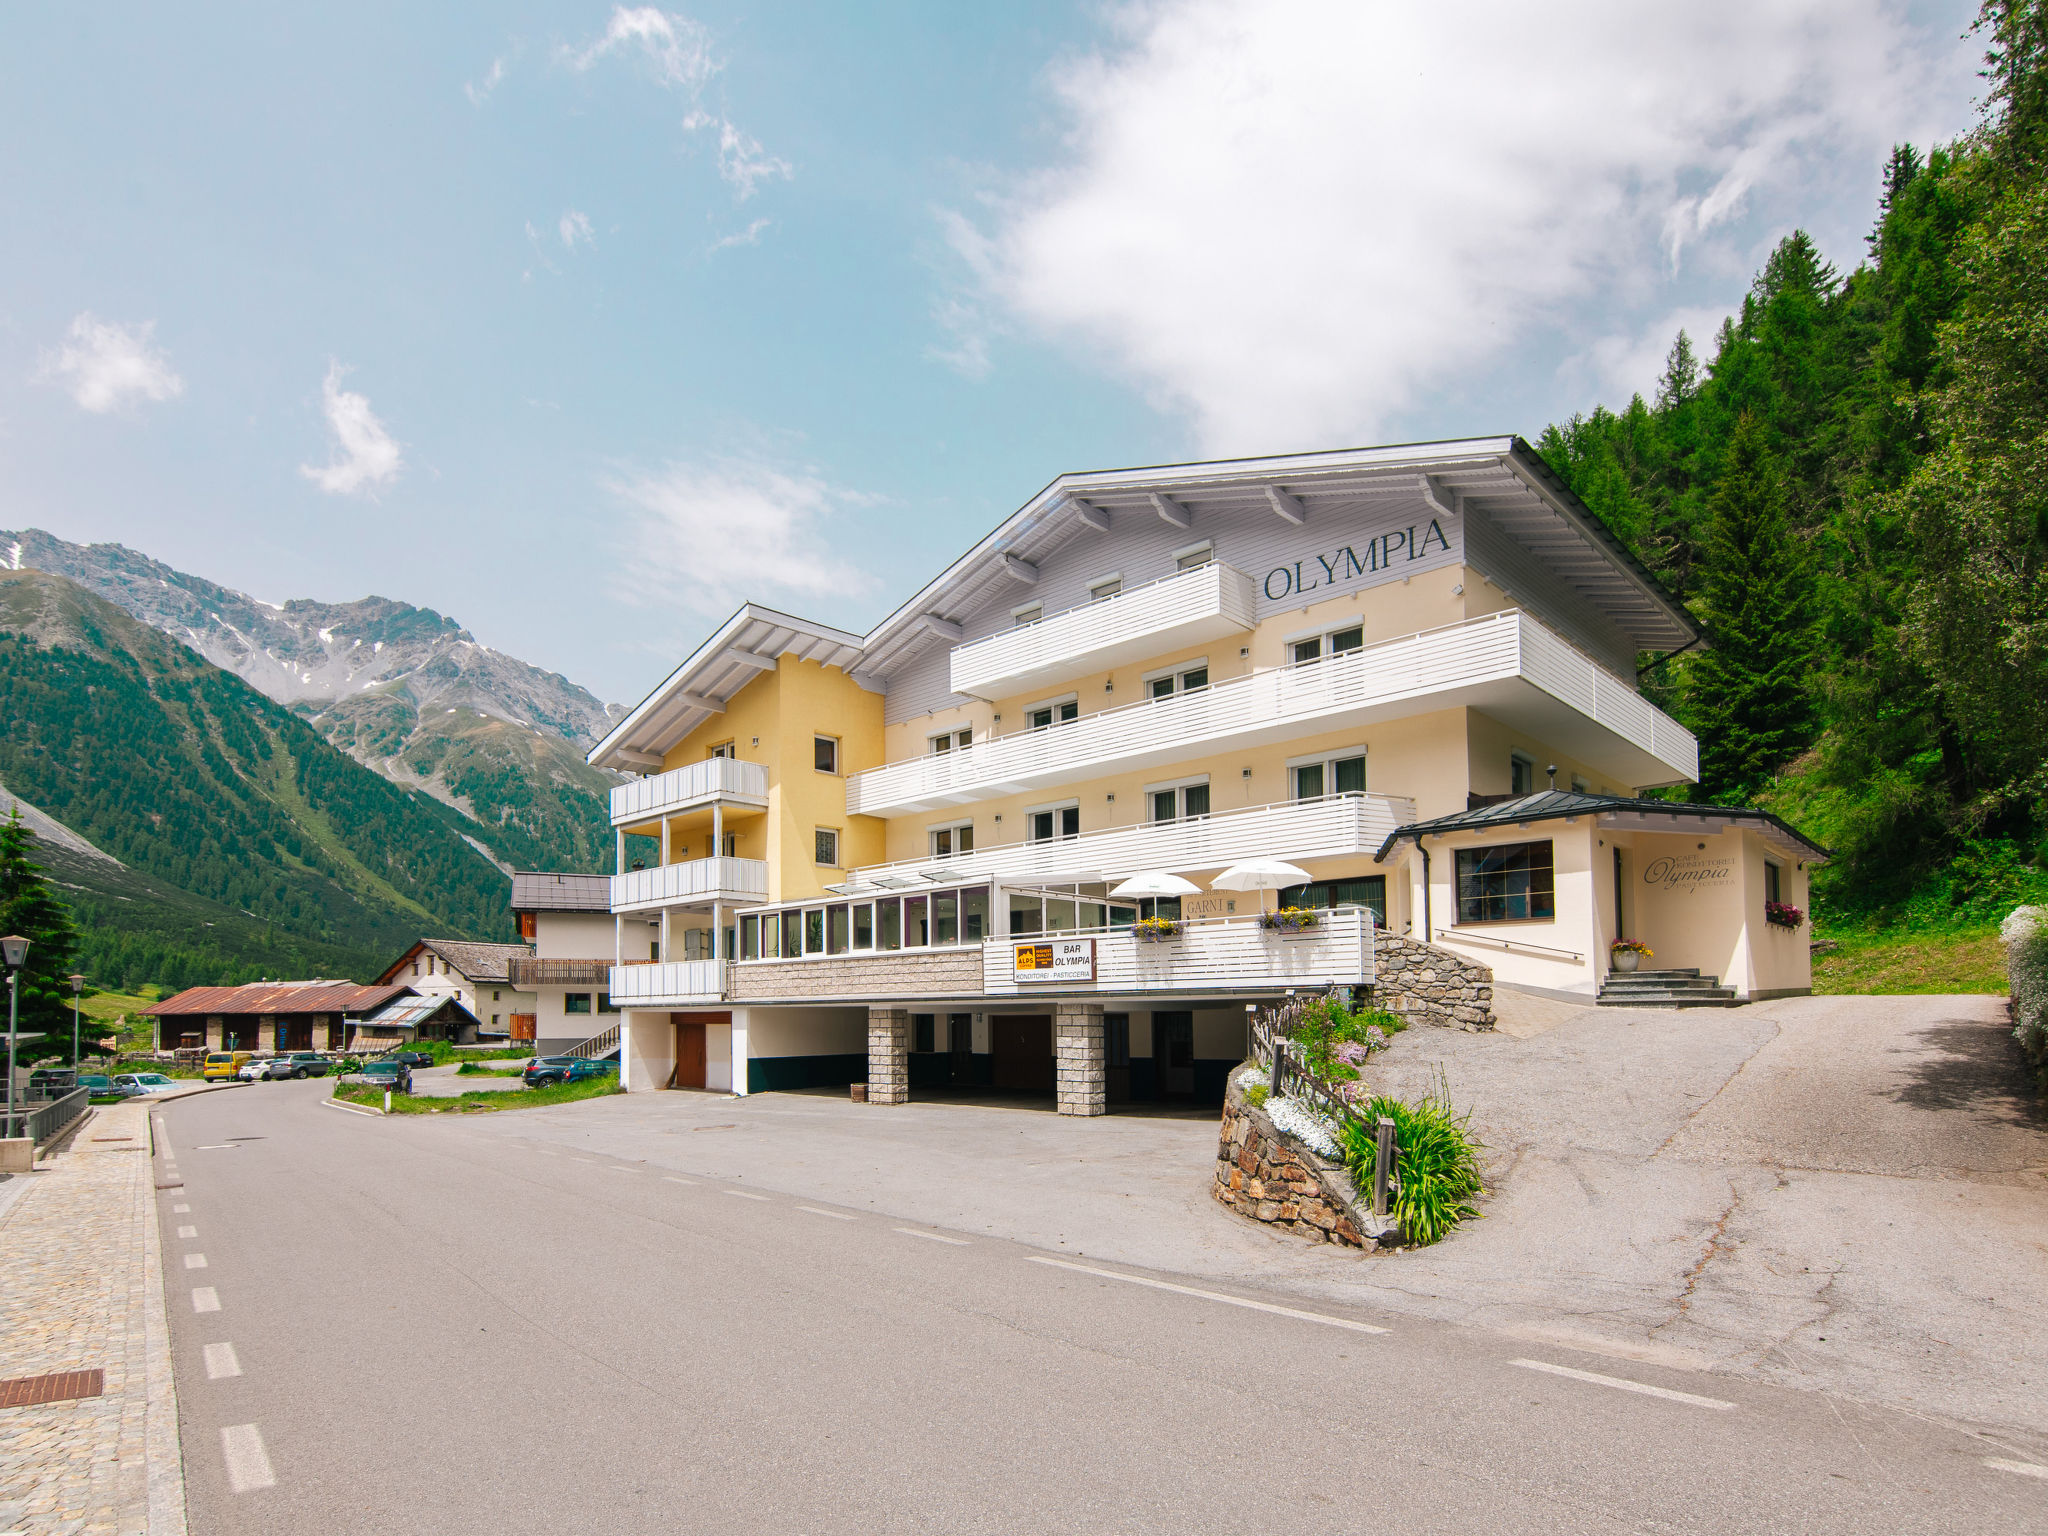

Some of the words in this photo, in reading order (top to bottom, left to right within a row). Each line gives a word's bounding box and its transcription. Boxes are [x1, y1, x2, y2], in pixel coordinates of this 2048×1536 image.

[1264, 518, 1451, 601] OLYMPIA
[1644, 856, 1729, 894] Olympia
[1187, 899, 1222, 913] GARNI
[1064, 945, 1081, 954] BAR
[1055, 956, 1090, 966] OLYMPIA
[1016, 972, 1049, 980] KONDITOREI
[1053, 971, 1090, 979] PASTICCERIA
